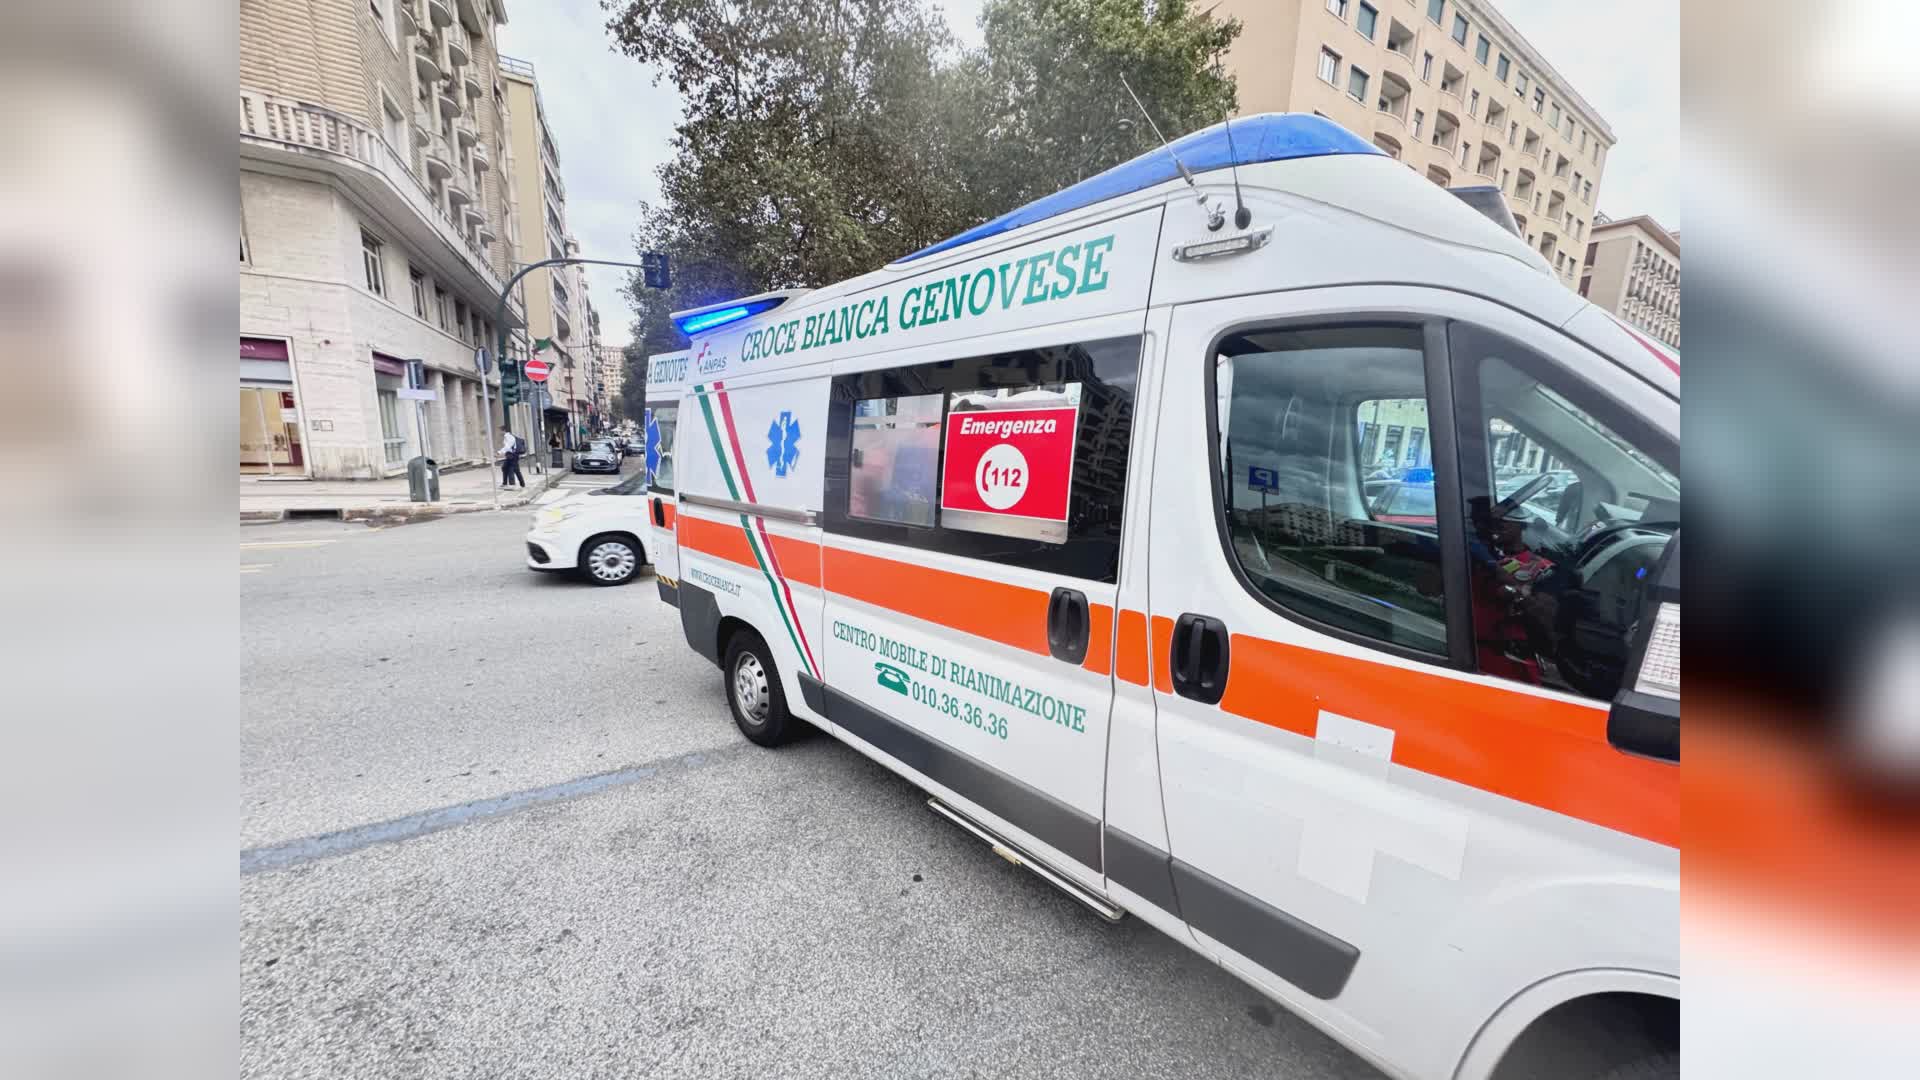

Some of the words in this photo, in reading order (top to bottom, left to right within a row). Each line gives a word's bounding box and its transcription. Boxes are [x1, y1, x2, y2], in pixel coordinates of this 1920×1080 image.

[741, 319, 800, 362] CROCE
[801, 295, 889, 350] BIANCA
[899, 234, 1115, 330] GENOVESE
[704, 356, 727, 370] ANPAS
[960, 417, 1057, 439] Emergenza
[991, 467, 1022, 487] 112
[833, 620, 877, 652] CENTRO
[879, 636, 928, 672] MOBILE
[931, 654, 948, 680] DI
[950, 661, 1087, 733] RIANIMAZIONE
[912, 681, 1009, 740] 010.36.36.36
